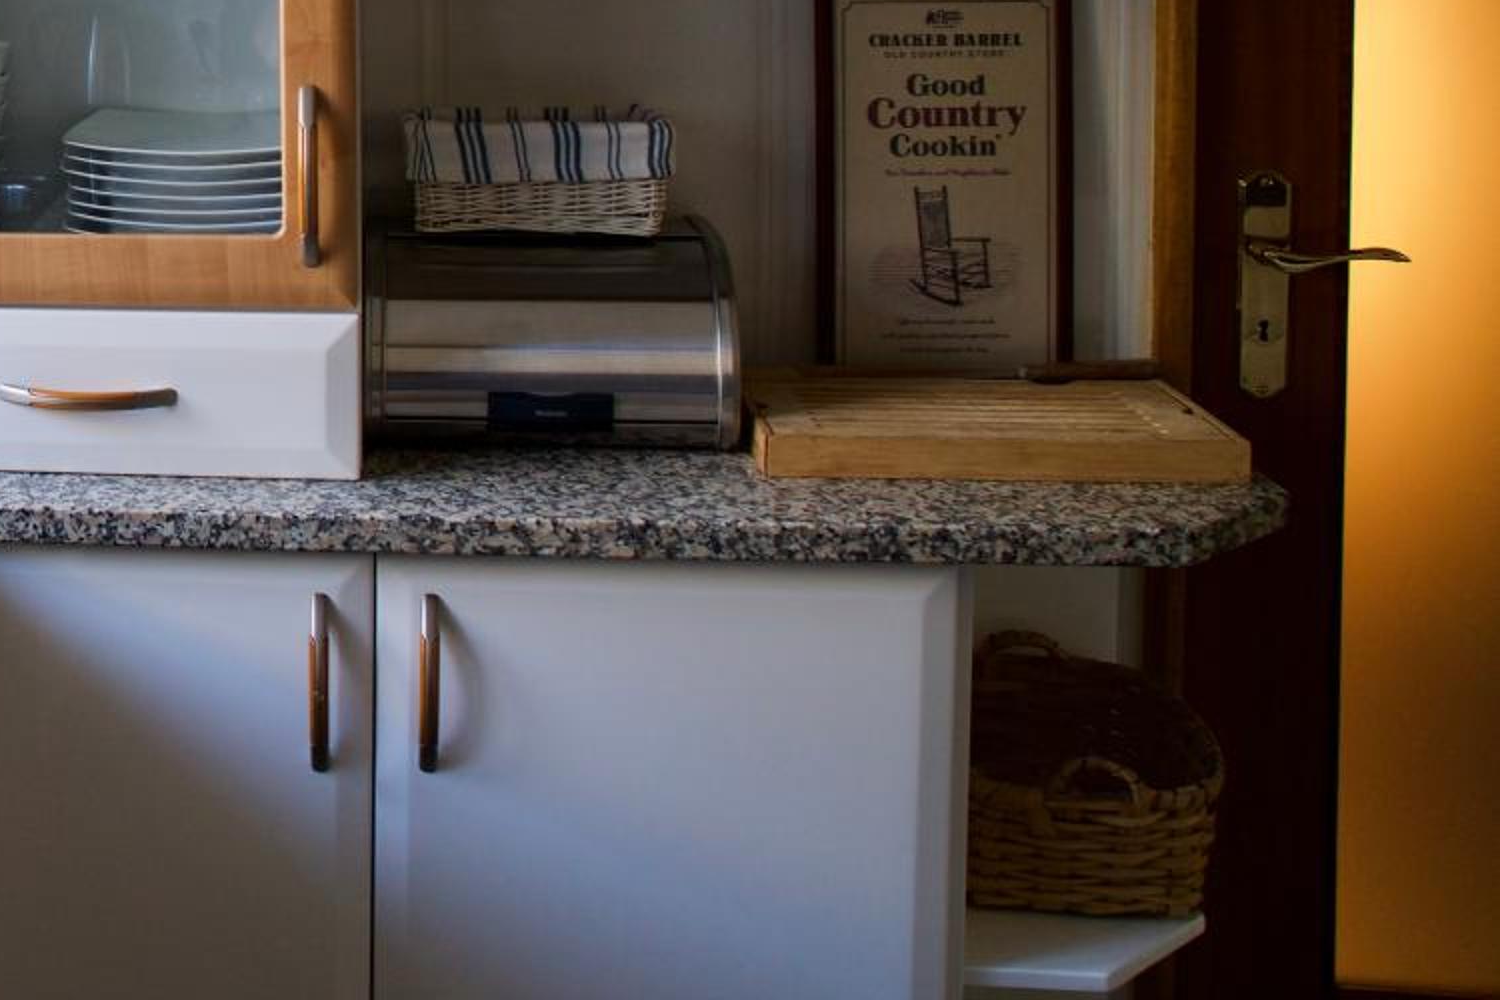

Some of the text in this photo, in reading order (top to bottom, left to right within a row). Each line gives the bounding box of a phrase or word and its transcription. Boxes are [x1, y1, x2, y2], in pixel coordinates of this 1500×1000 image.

[869, 33, 1023, 47] CRACKER BARREL
[906, 73, 986, 97] Good
[868, 97, 1027, 136] Country
